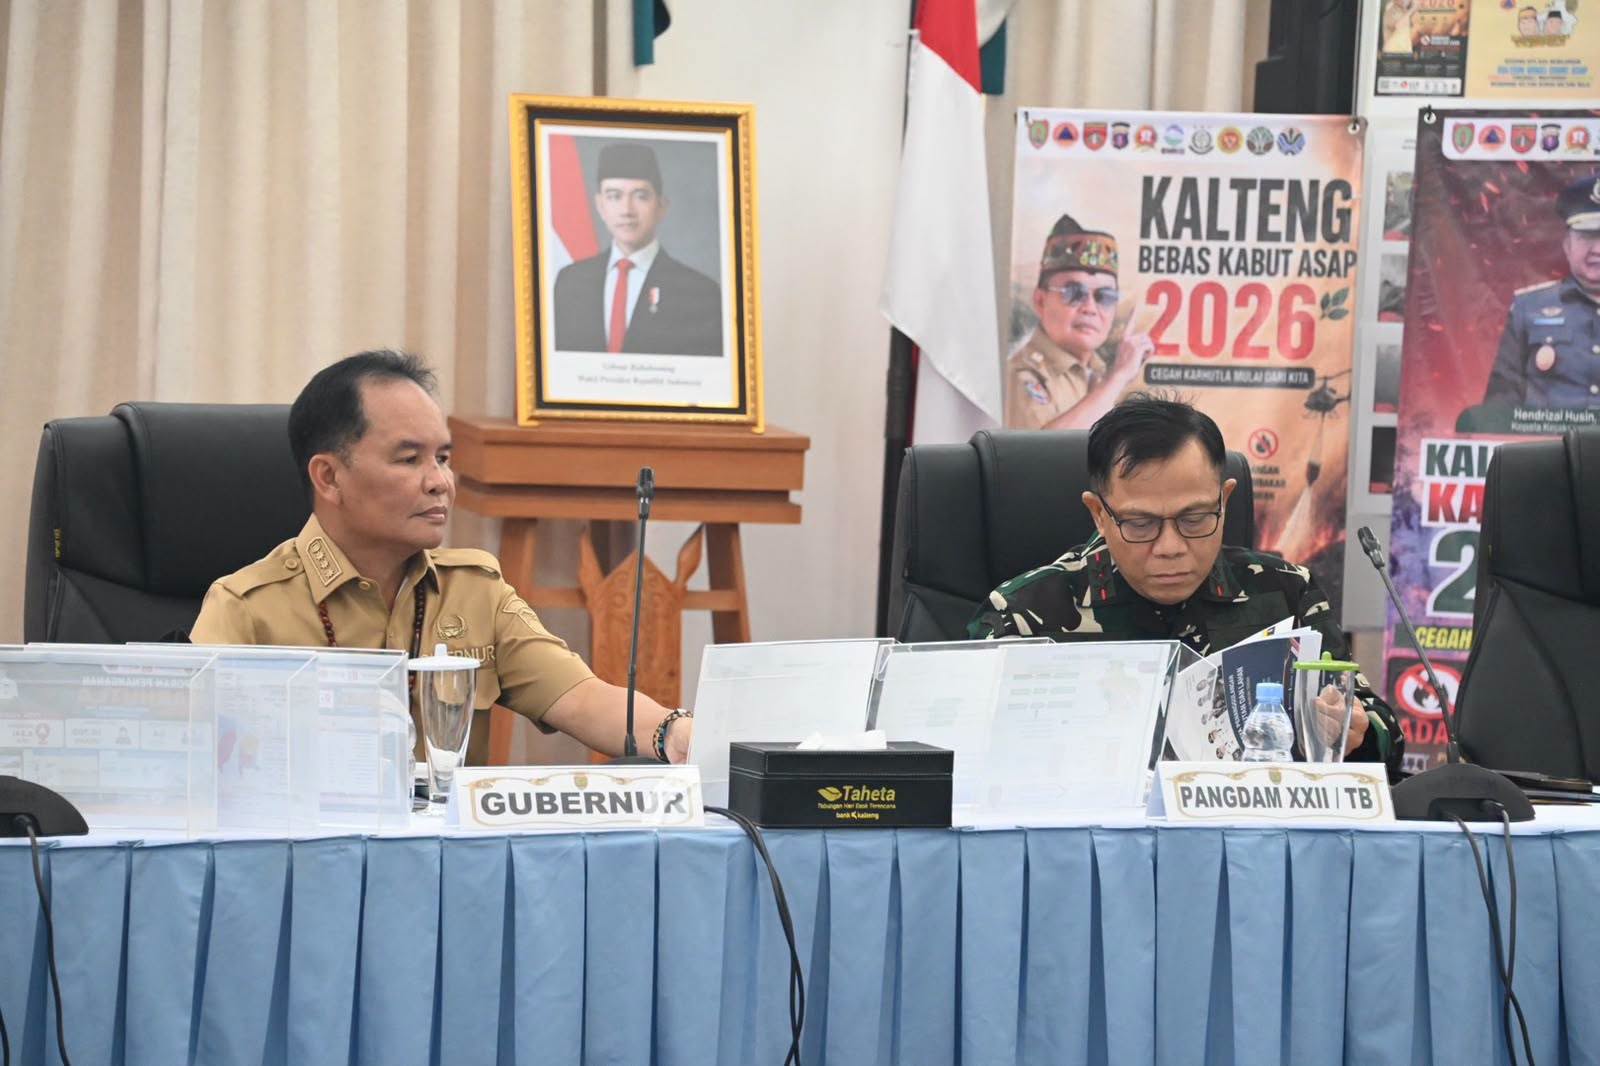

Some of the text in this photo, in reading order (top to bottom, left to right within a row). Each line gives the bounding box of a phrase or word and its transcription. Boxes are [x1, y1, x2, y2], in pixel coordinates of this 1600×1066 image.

[1140, 176, 1353, 243] KALTENG
[1138, 245, 1358, 279] BEBAS KABUT ASAP
[1145, 279, 1317, 362] 2026
[1150, 367, 1182, 381] CEGAH
[480, 791, 688, 816] GUBERNUR
[842, 785, 896, 801] Taheta
[1180, 785, 1282, 809] PANGDAM
[1286, 787, 1330, 809] XXII
[1344, 787, 1373, 809] TB
